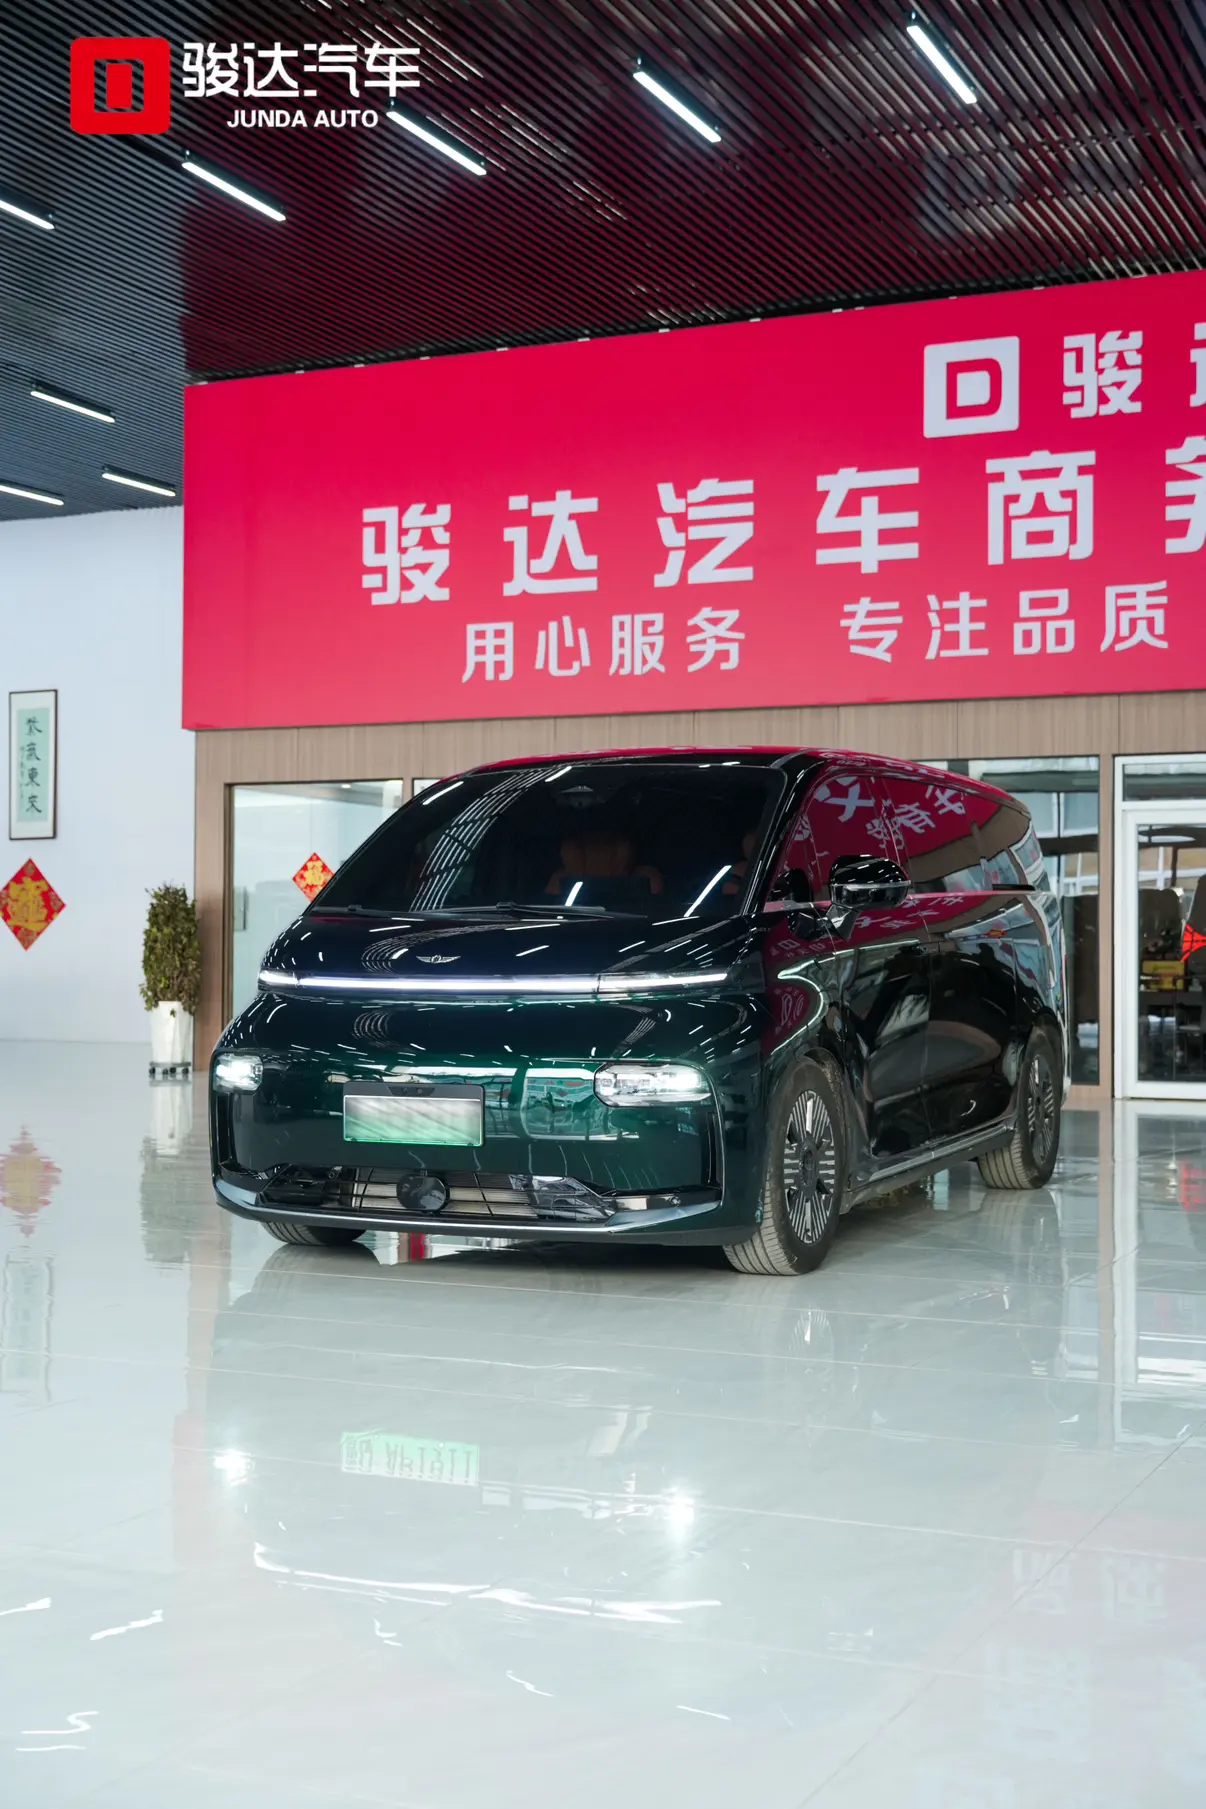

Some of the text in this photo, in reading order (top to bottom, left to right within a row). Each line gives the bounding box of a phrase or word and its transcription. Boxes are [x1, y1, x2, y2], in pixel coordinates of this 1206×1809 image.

[462, 580, 1169, 683] 用心服务 专注品质
